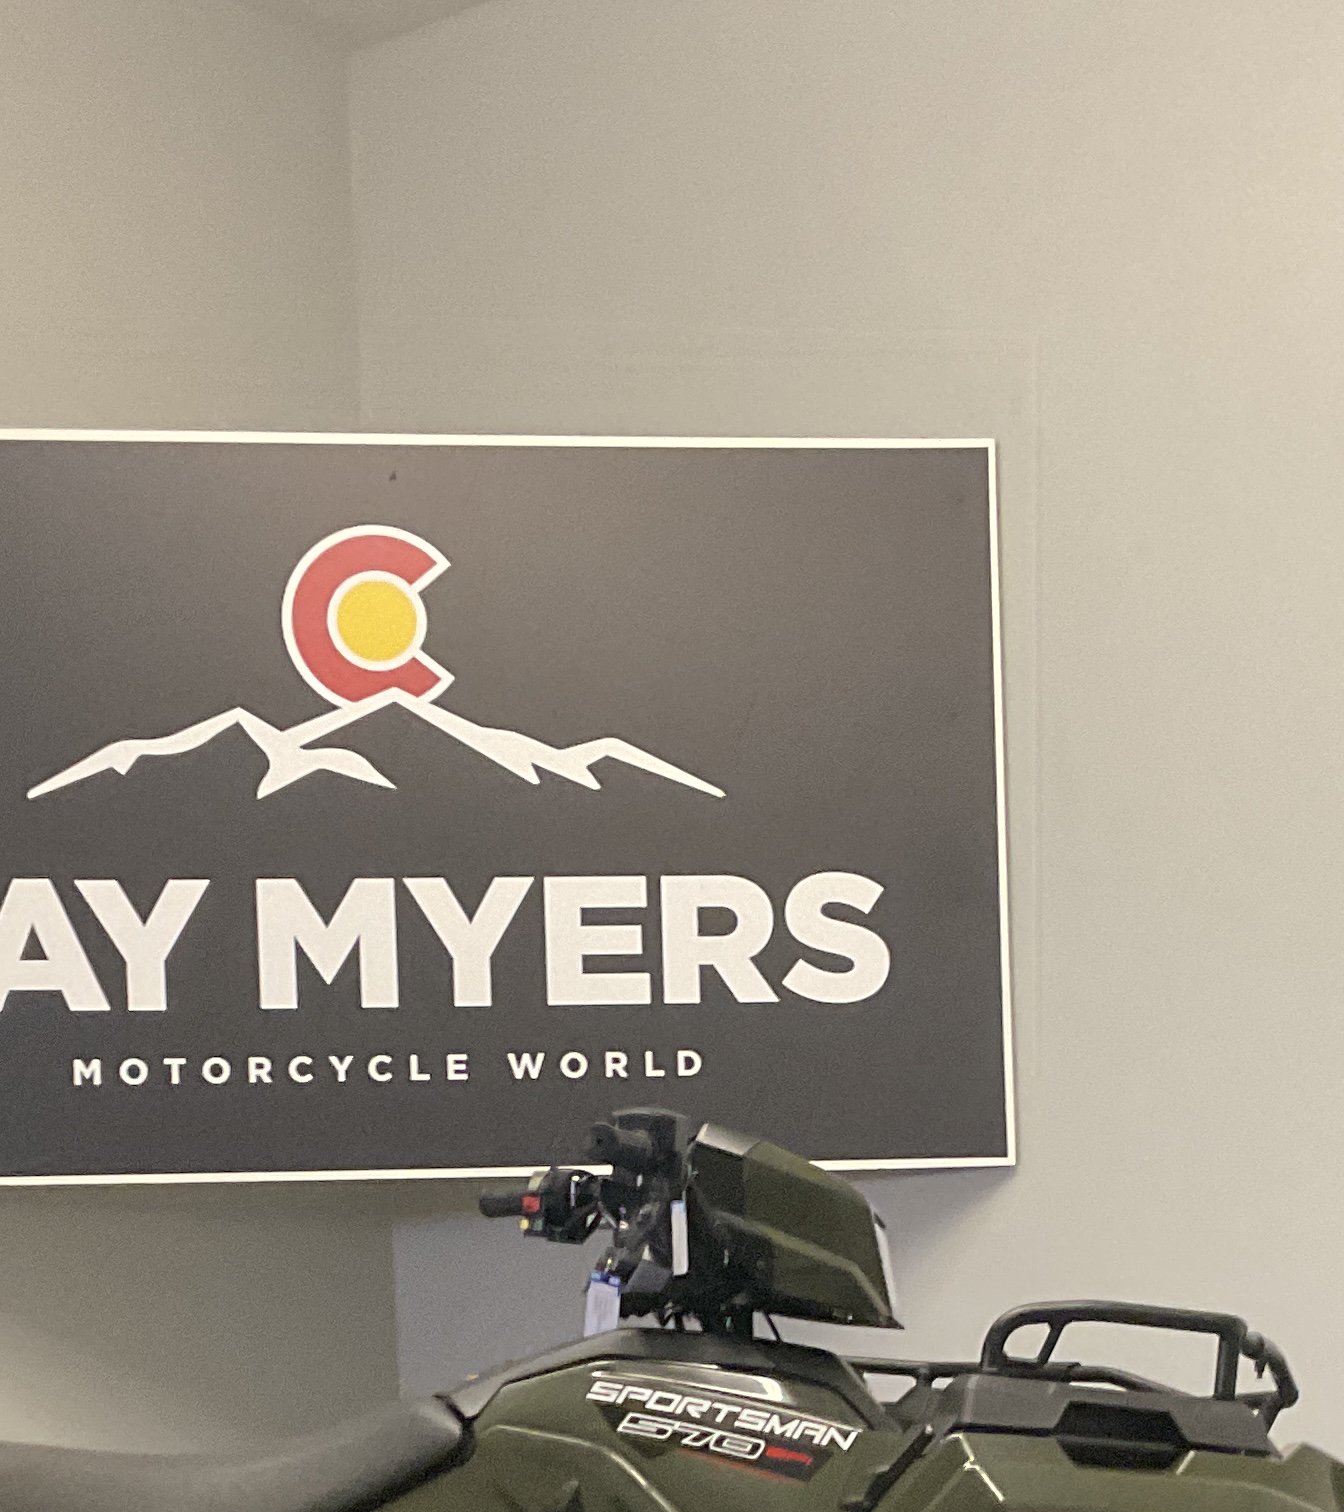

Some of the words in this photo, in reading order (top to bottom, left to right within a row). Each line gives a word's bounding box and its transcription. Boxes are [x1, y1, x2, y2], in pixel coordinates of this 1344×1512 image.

[255, 871, 891, 1010] MYERS
[72, 1053, 469, 1086] MOTORCYCLE
[506, 1049, 702, 1080] WORLD
[585, 1379, 861, 1451] SPORTSMAN
[617, 1411, 767, 1461] 570
